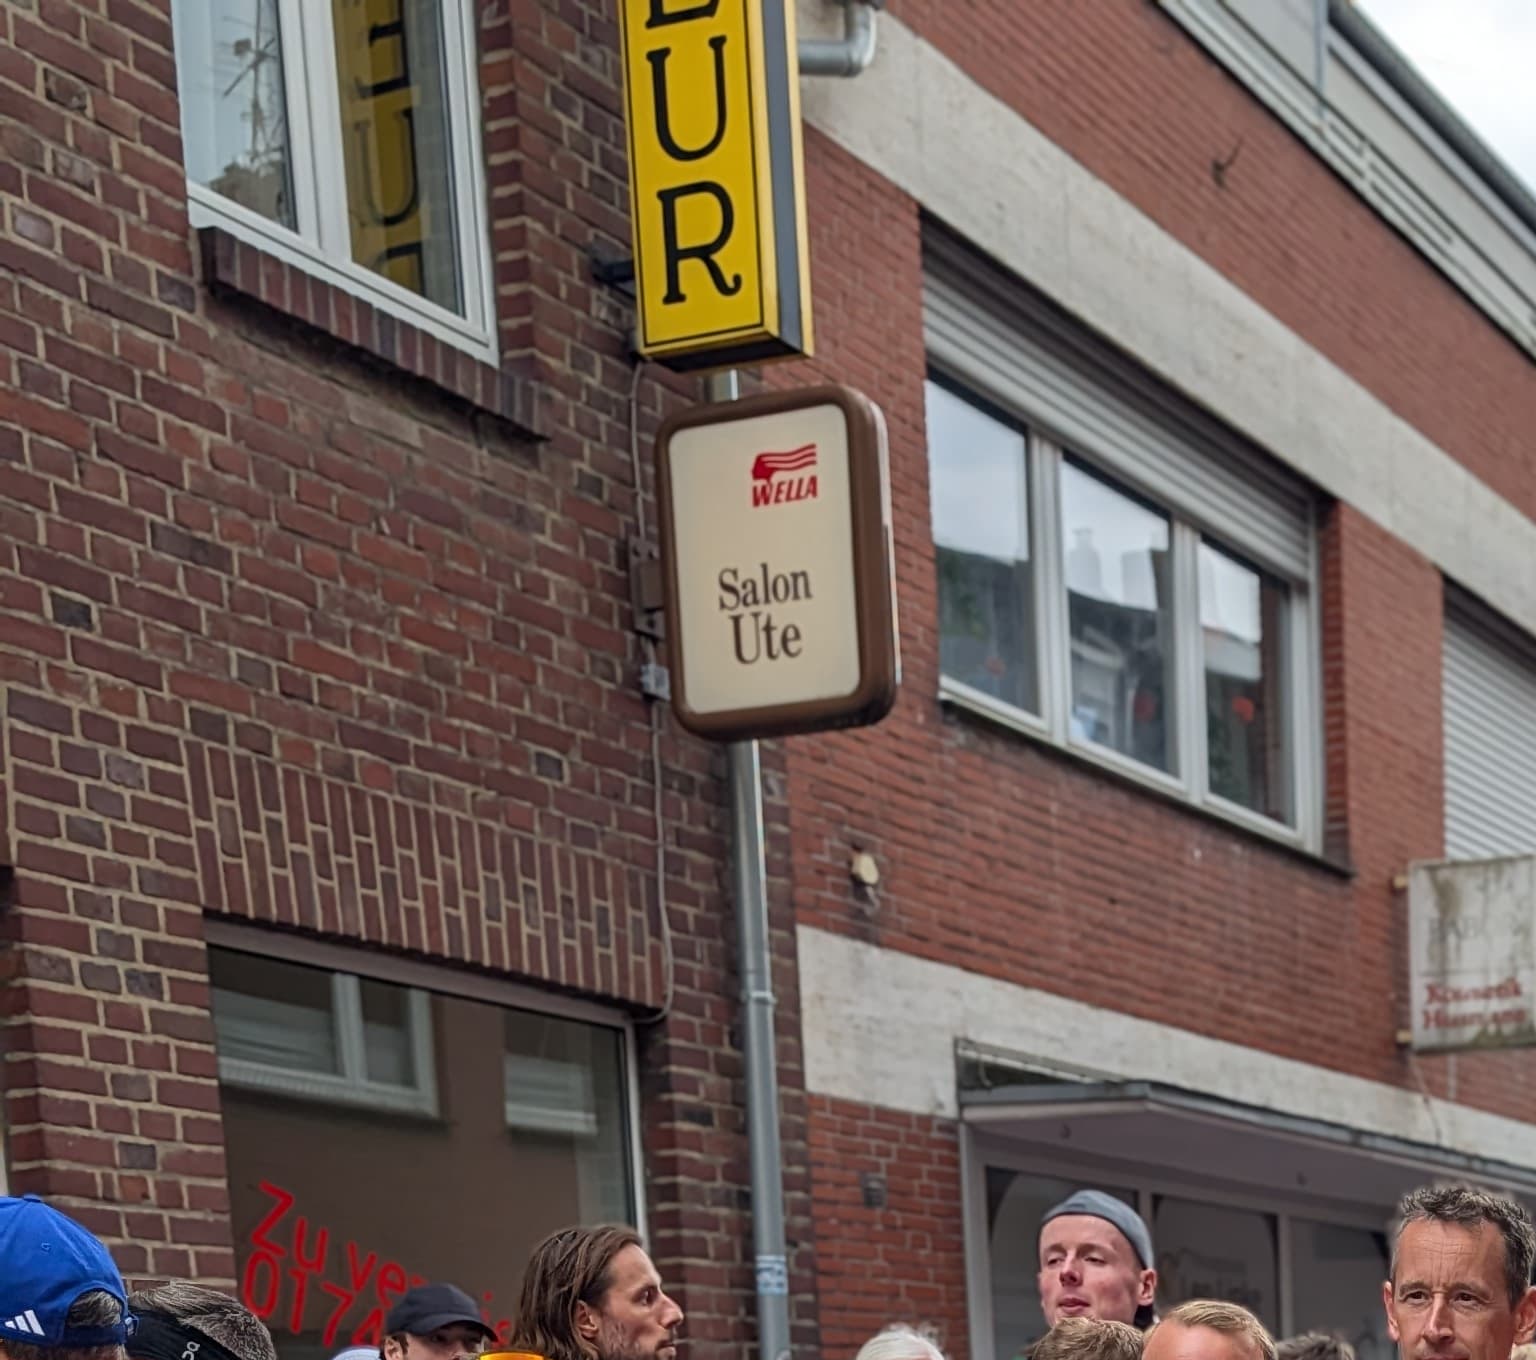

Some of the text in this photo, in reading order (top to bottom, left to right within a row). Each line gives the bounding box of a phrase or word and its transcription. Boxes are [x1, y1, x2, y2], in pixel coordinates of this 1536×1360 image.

[645, 0, 742, 305] UR
[751, 475, 818, 508] WELLA
[718, 562, 813, 611] Salon
[729, 611, 803, 665] Ute
